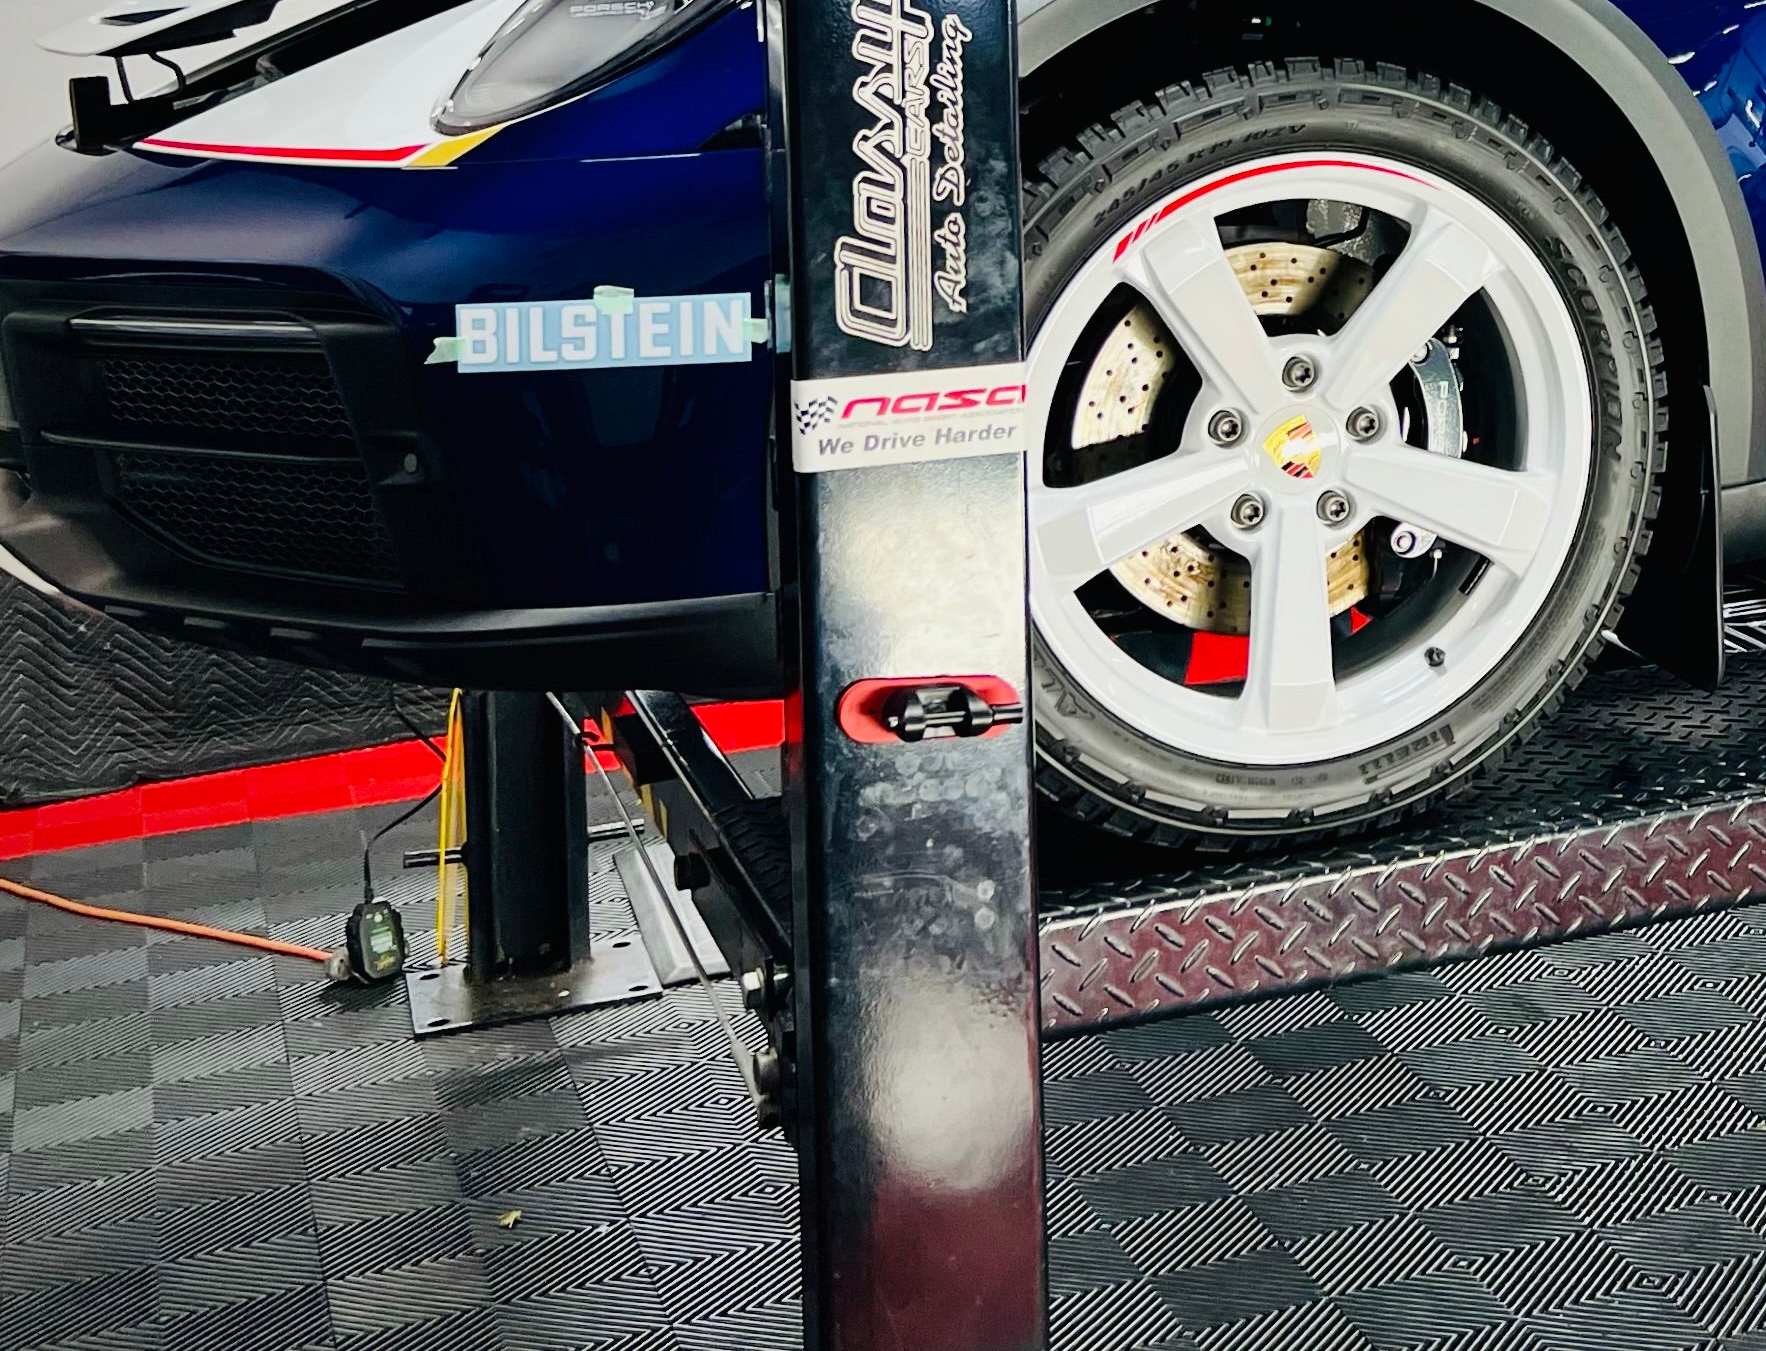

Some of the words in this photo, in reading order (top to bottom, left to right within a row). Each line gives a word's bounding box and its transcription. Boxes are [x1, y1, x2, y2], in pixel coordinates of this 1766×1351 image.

[569, 0, 655, 13] PORSCH
[931, 13, 973, 207] Detailing
[933, 211, 968, 314] Auto
[458, 299, 745, 366] BILSTEIN
[818, 437, 854, 456] We
[863, 431, 926, 451] Drive
[934, 424, 1017, 445] Harder
